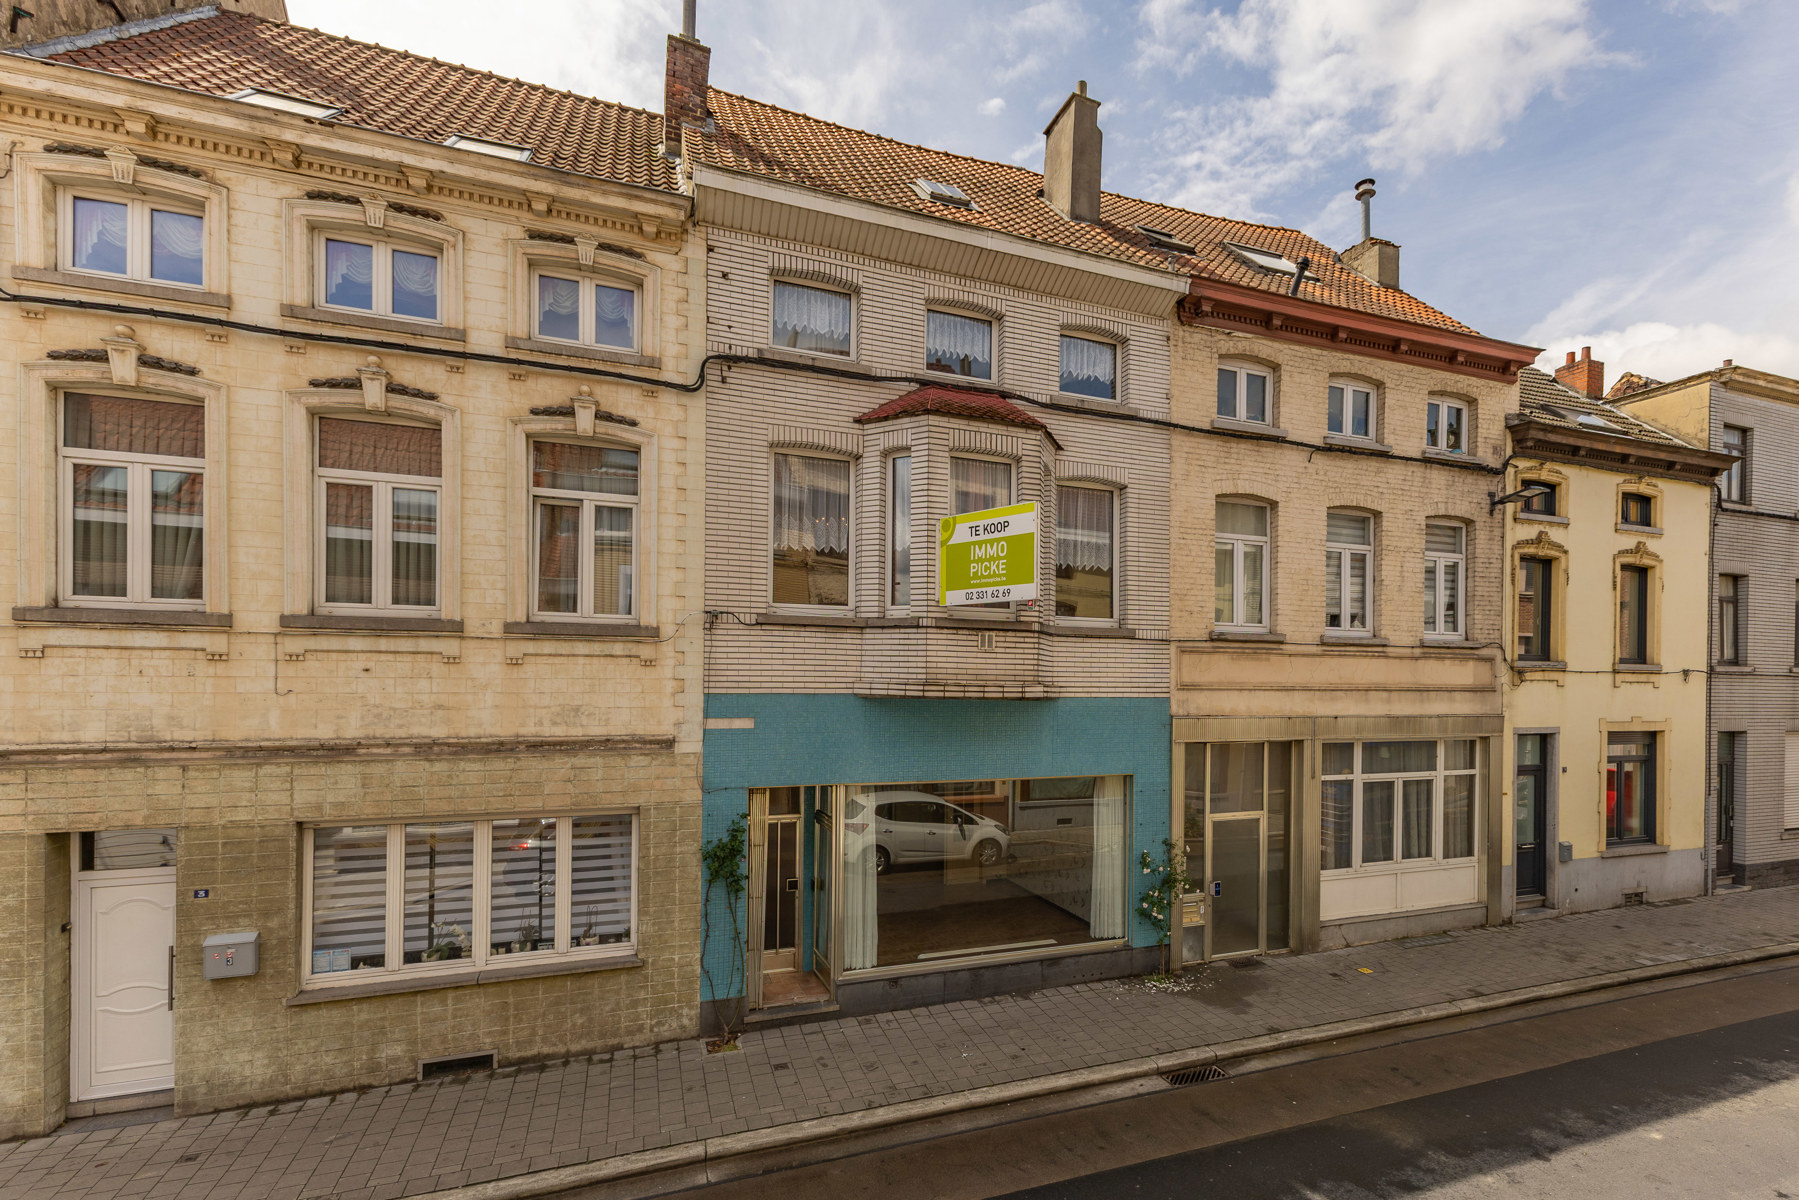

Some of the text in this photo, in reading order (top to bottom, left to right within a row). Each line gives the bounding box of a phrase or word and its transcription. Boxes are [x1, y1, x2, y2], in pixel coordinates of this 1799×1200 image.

[968, 520, 1010, 537] TE KOOP
[970, 541, 1007, 560] IMMO
[970, 560, 1007, 577] PICKE
[965, 588, 1011, 600] 02 331 62 69
